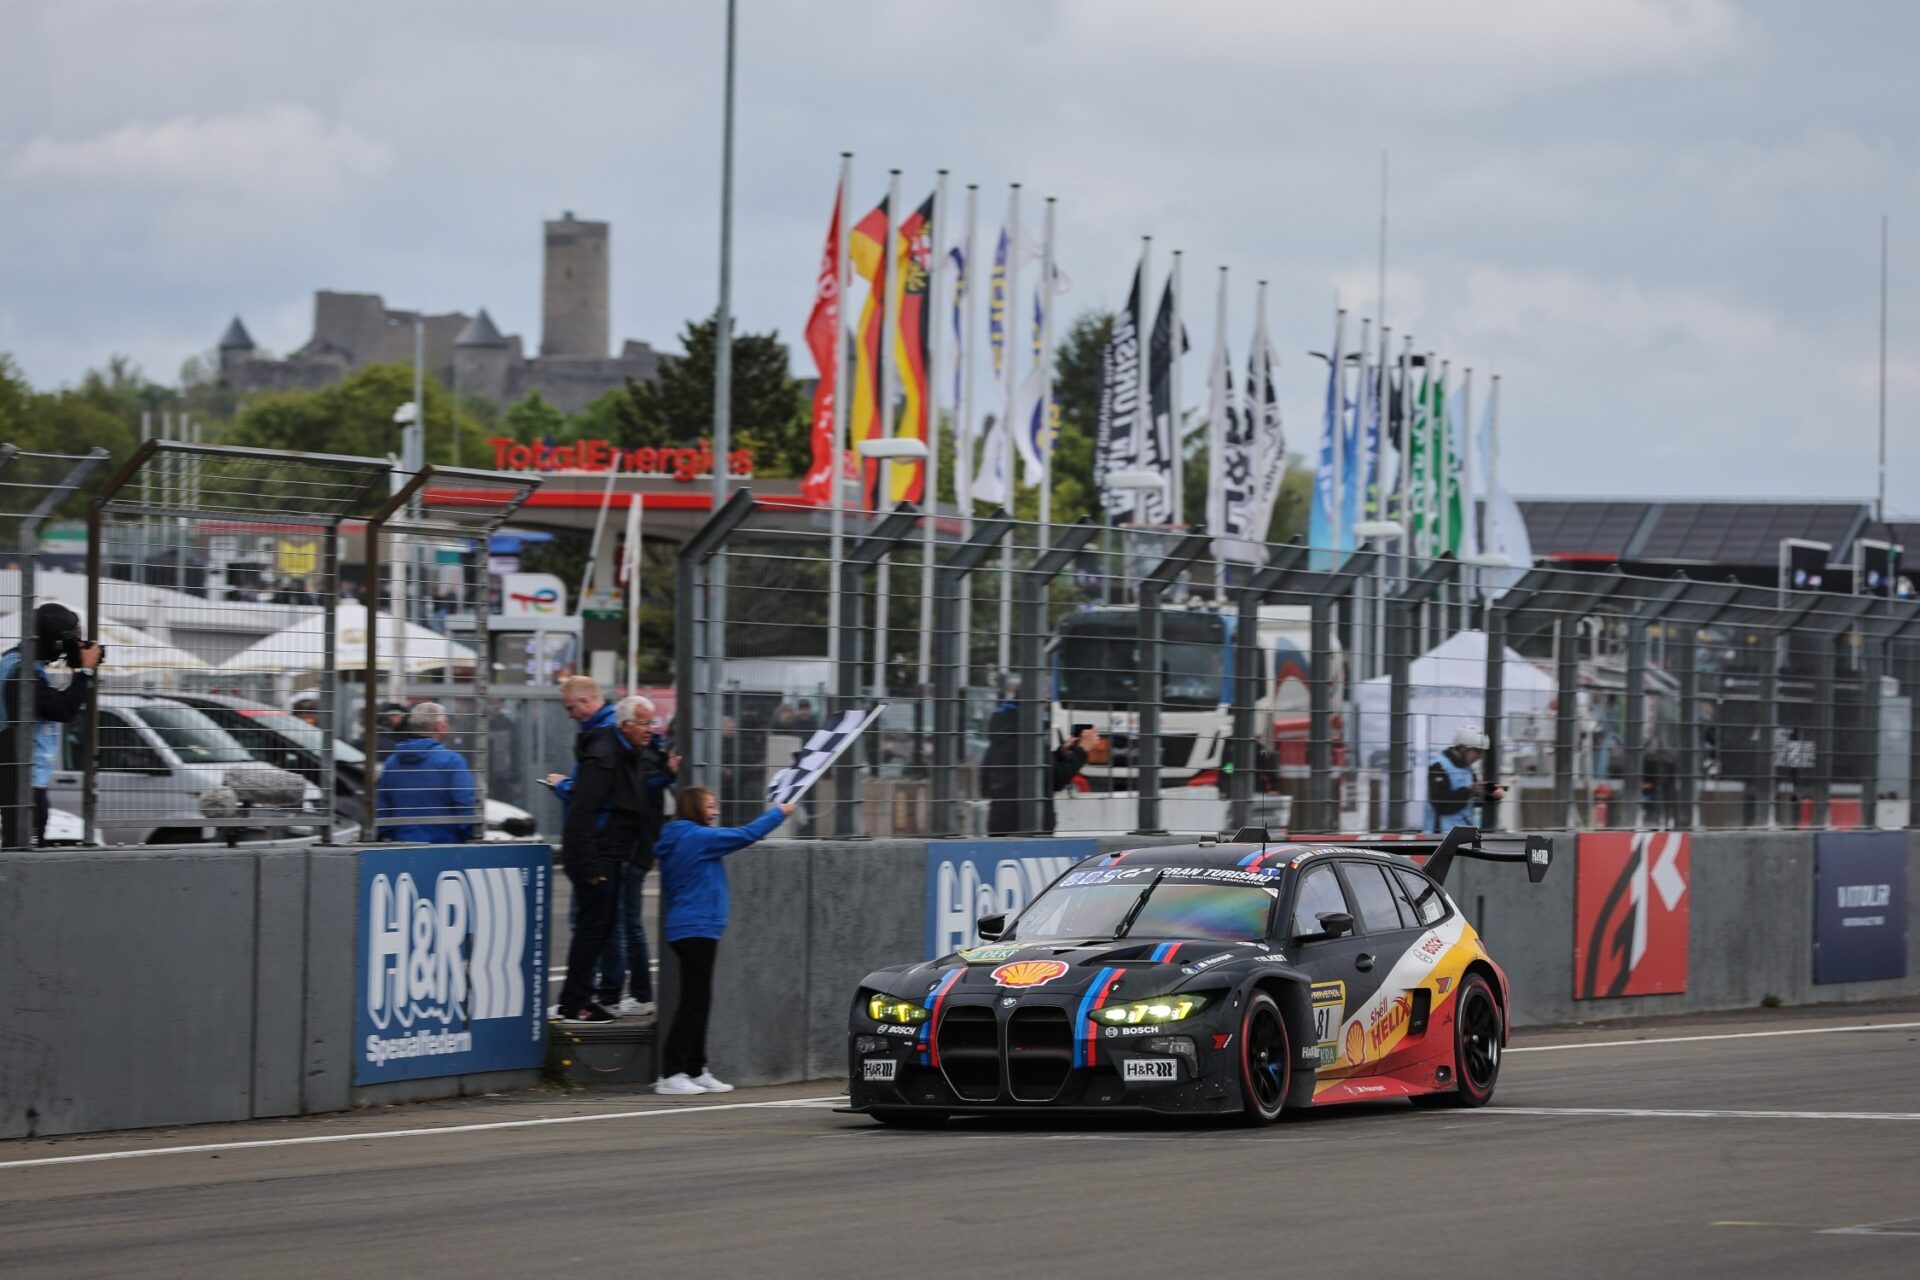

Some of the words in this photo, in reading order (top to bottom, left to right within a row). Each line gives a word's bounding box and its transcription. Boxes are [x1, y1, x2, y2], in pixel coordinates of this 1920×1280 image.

[487, 437, 753, 480] TotalEnergis
[368, 871, 473, 1028] H&R
[1316, 1008, 1330, 1040] 81
[1370, 996, 1388, 1026] Shell
[1370, 997, 1412, 1050] HELIX
[887, 1025, 917, 1035] BOSCH
[1122, 1026, 1159, 1035] BOSCH
[366, 1028, 472, 1067] Spezialfedern
[1127, 1063, 1155, 1076] H&R
